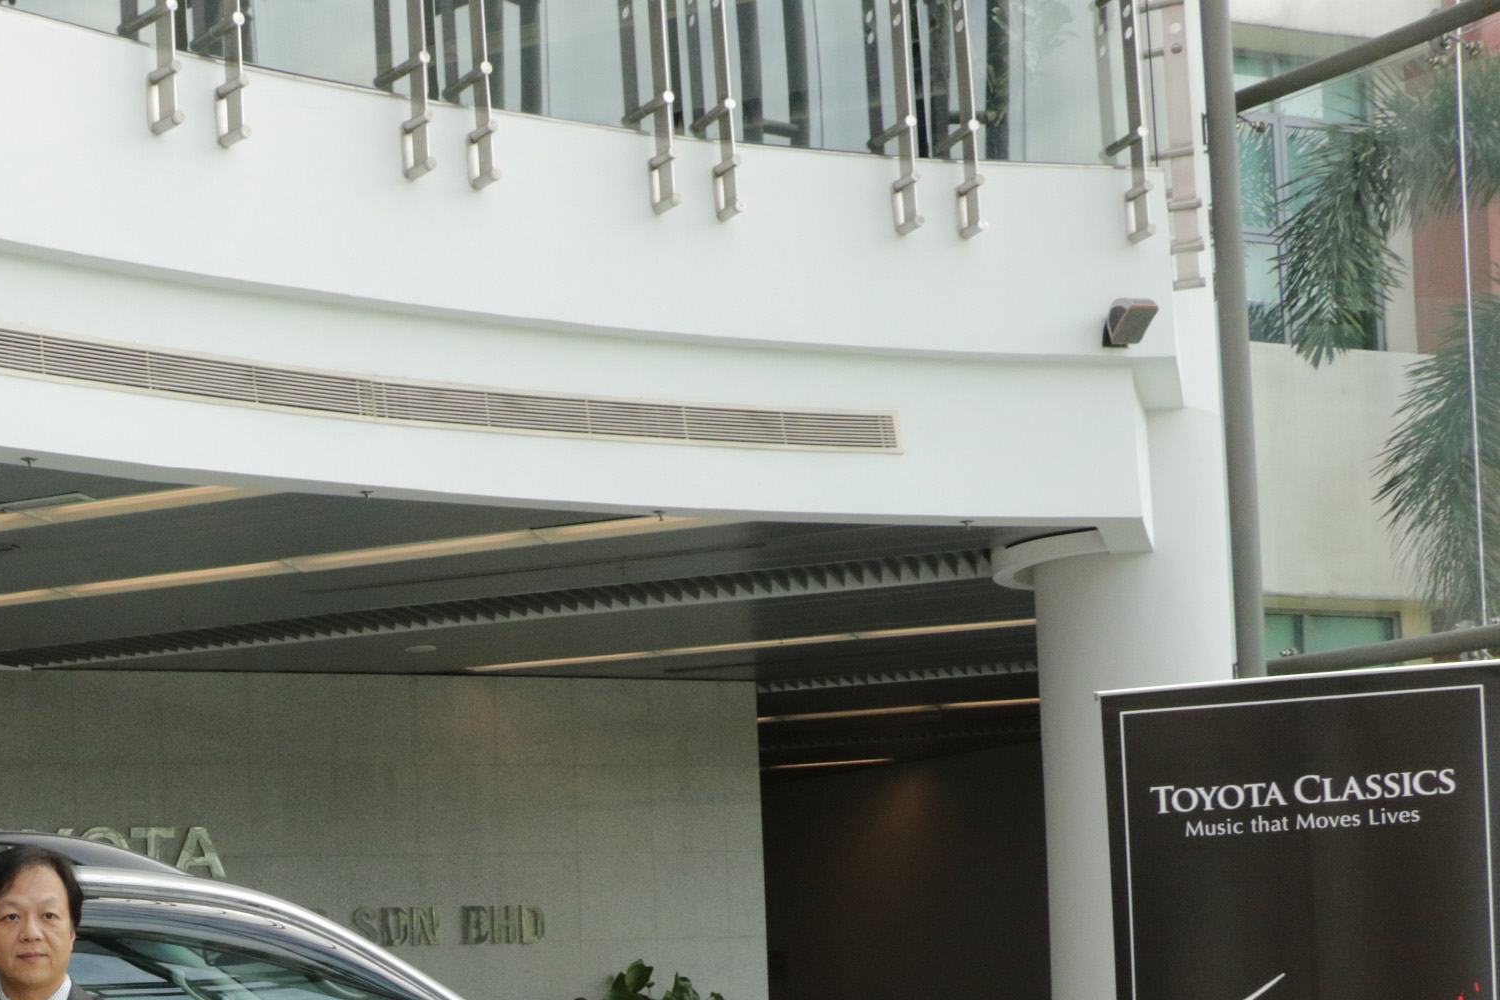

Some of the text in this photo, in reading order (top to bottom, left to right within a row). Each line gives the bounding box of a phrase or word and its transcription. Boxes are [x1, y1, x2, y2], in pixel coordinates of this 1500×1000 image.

[1150, 768, 1456, 814] TOYOTA CLASSICS
[1185, 807, 1421, 838] Music that Moves Lives
[353, 905, 440, 948] SDN
[460, 904, 543, 946] BHD
